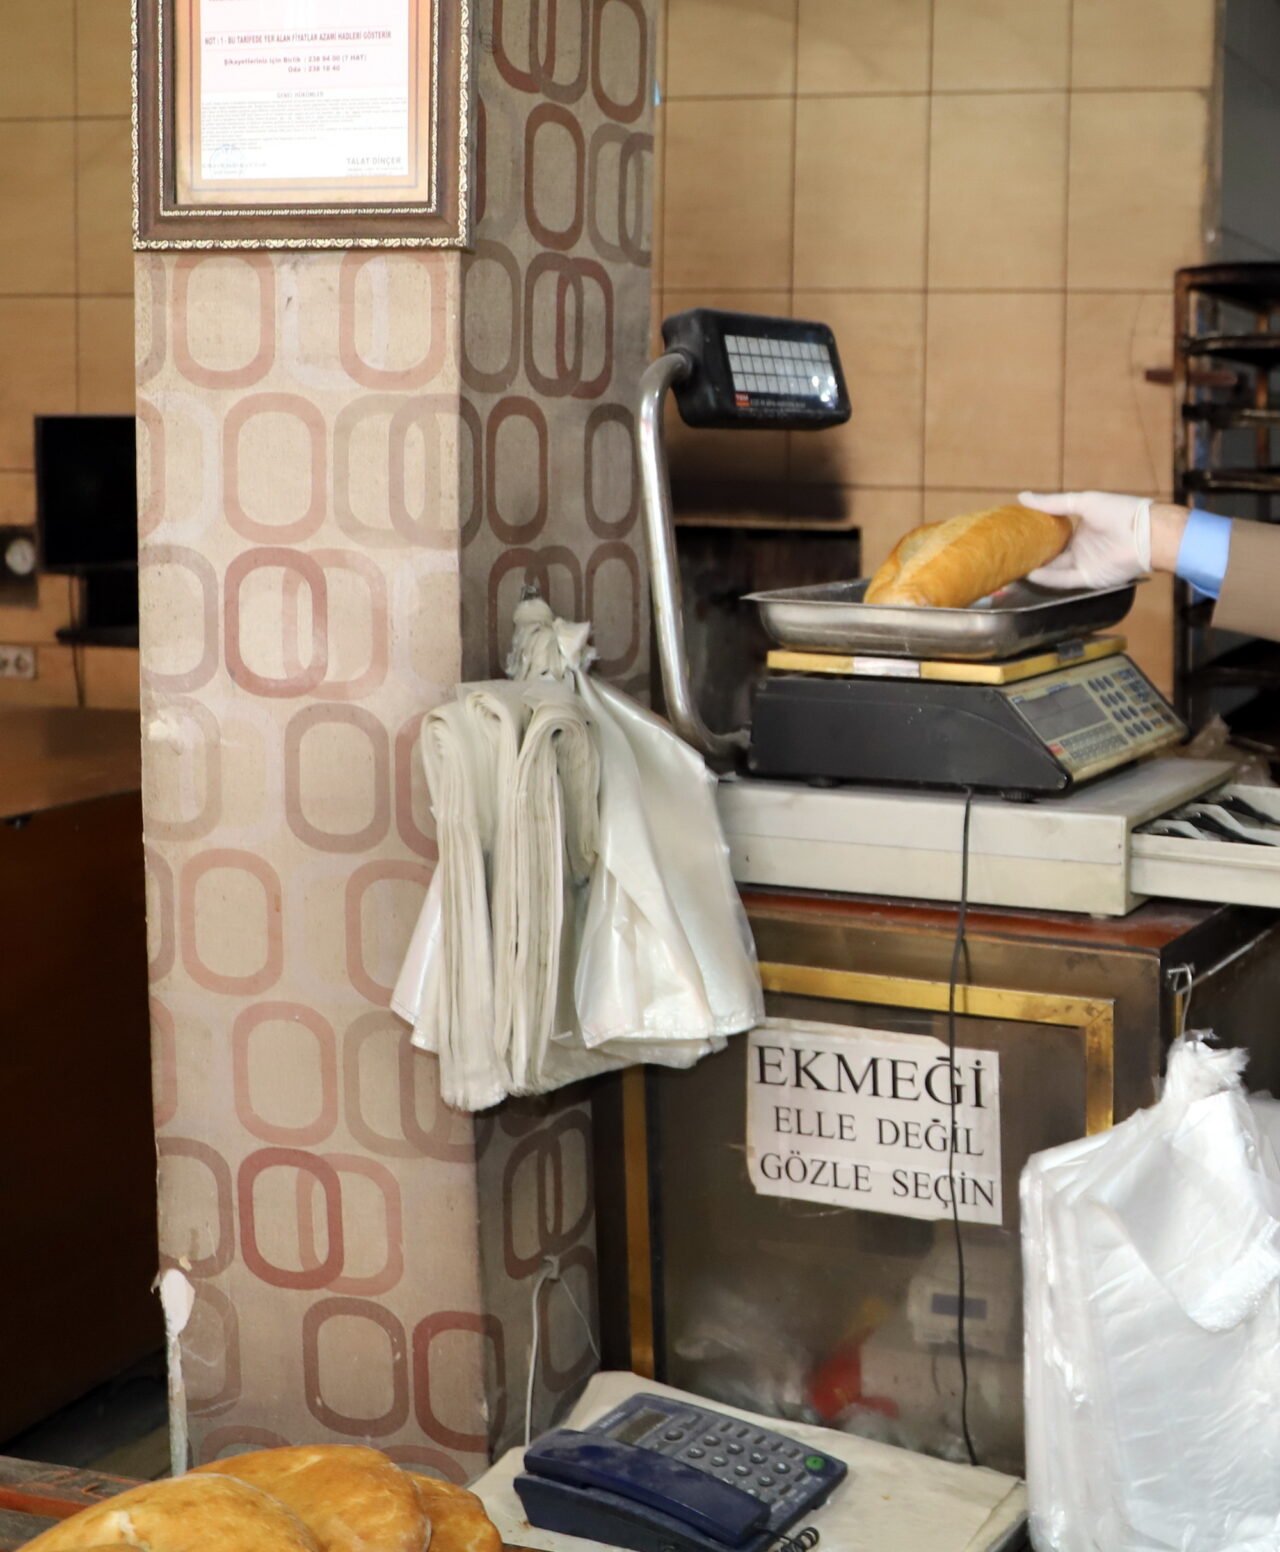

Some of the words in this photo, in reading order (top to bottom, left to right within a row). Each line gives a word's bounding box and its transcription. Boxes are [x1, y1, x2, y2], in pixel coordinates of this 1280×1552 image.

[205, 36, 216, 45] NOT
[228, 35, 236, 44] BU
[264, 34, 275, 43] YER
[276, 33, 291, 42] ALAN
[292, 31, 318, 42] FİYATLAR
[346, 156, 371, 166] TALAT
[754, 1045, 987, 1109] EKMEĞİ
[773, 1105, 857, 1142] ELLE
[877, 1117, 985, 1156] DEĞİL
[760, 1150, 872, 1193] GÖZLE
[892, 1168, 995, 1209] SEÇİN
